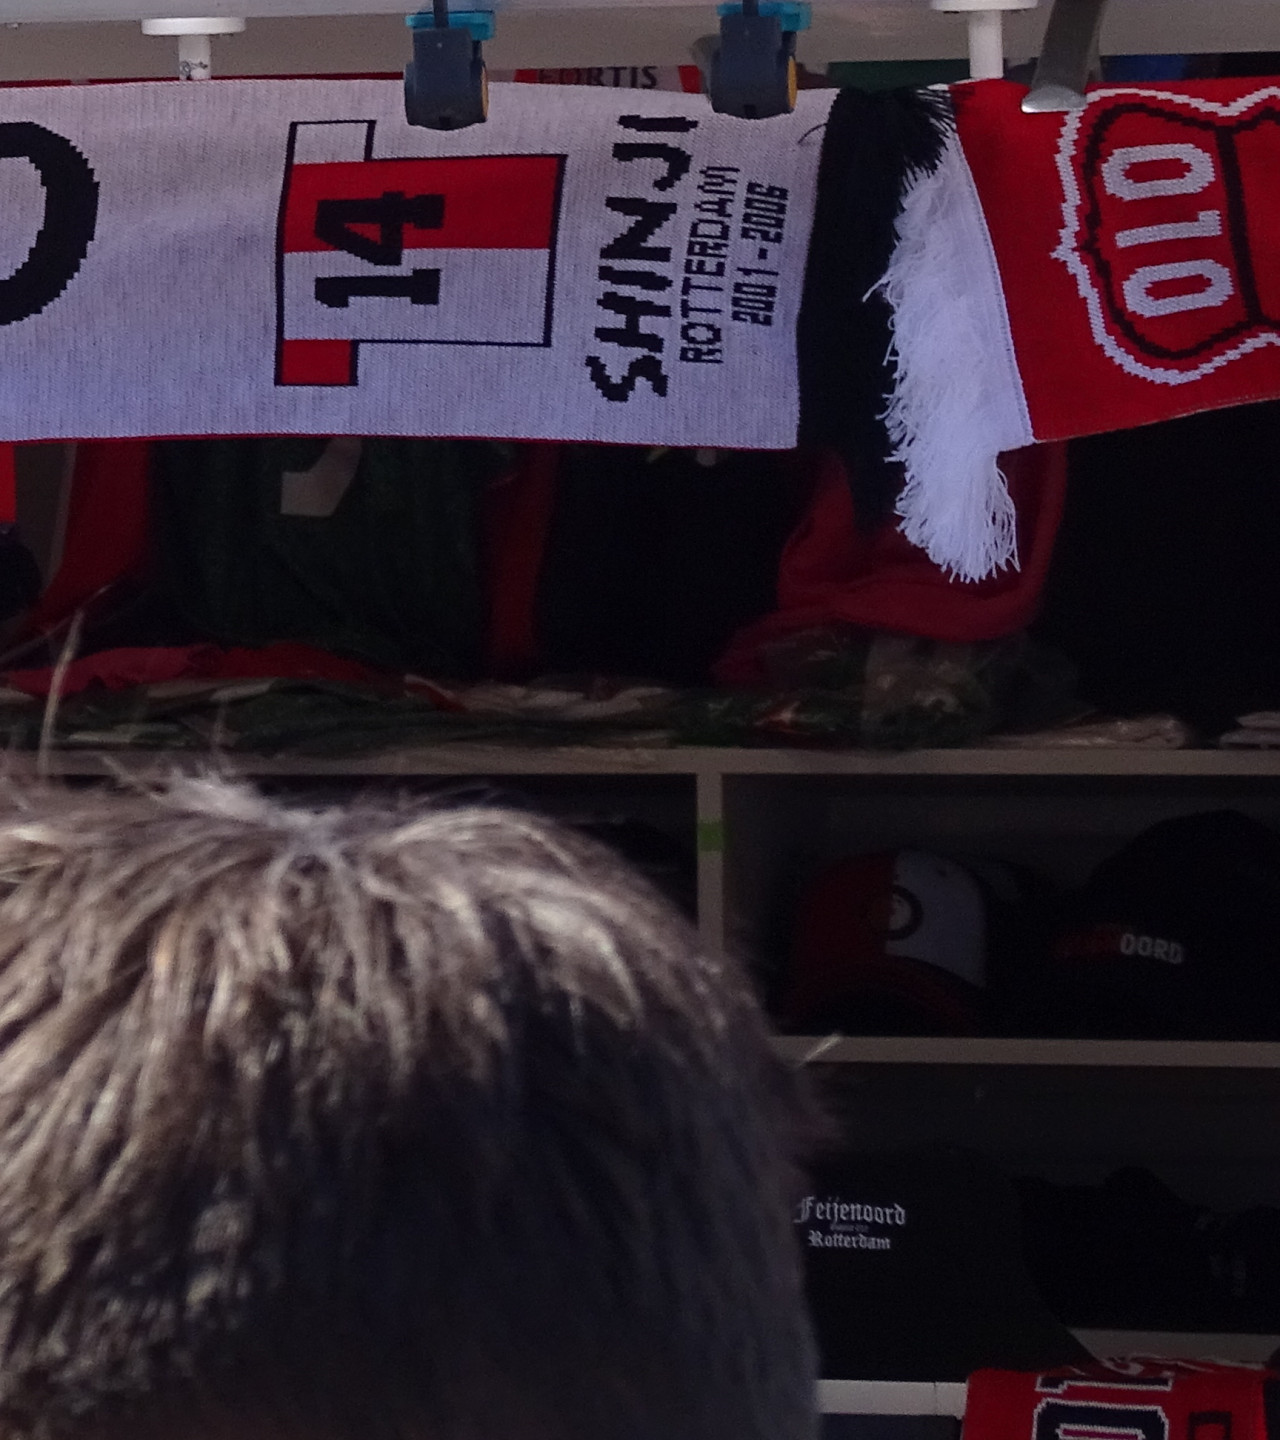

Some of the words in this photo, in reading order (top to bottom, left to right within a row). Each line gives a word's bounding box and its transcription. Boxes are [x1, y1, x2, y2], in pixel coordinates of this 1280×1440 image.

[314, 191, 445, 308] 14
[586, 114, 697, 403] SHINJI
[680, 166, 740, 364] ROTTERDAM
[1100, 143, 1235, 318] 010
[793, 1195, 906, 1226] Feijenoord
[807, 1229, 891, 1250] Rotterdam
